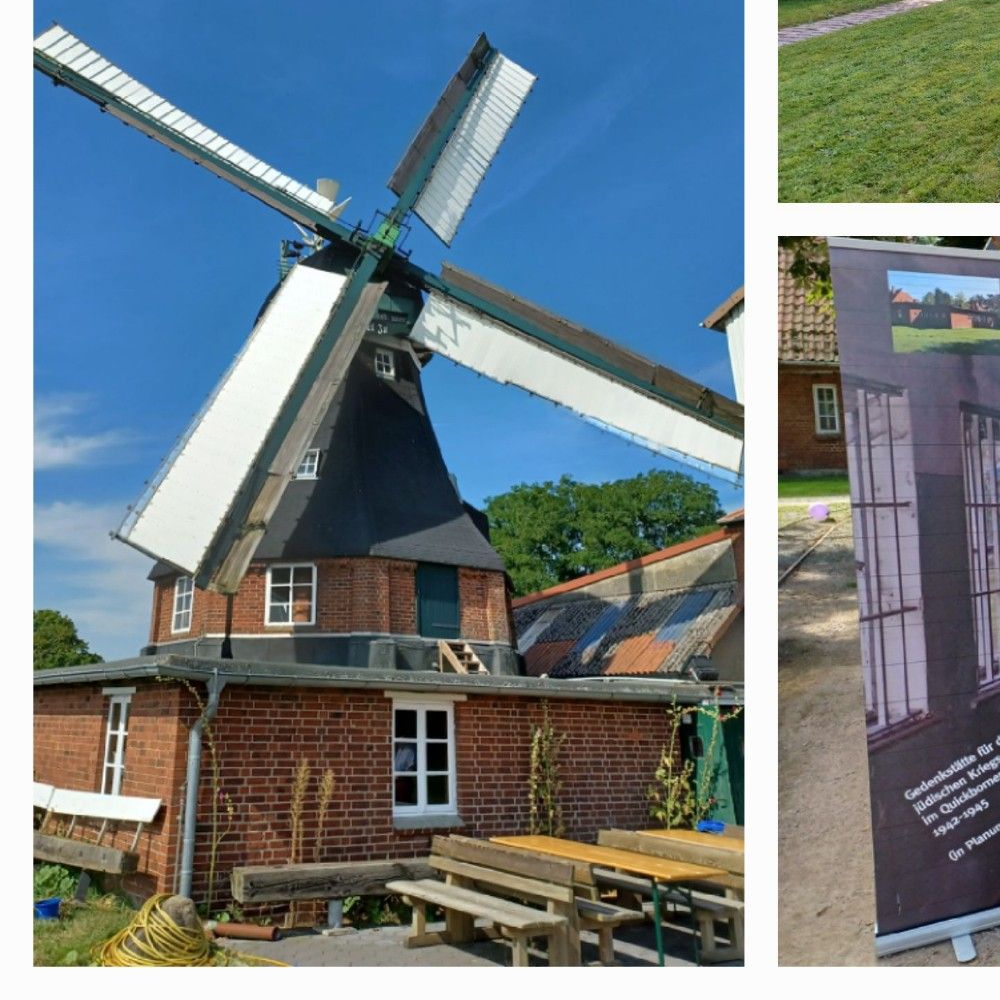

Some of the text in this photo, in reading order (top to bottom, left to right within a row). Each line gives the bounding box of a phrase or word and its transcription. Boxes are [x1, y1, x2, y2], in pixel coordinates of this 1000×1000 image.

[904, 754, 977, 800] Gedenkstätte
[976, 742, 994, 757] für
[912, 778, 967, 815] jüdischen
[921, 812, 939, 826] im
[932, 799, 989, 837] 1942-1945
[948, 848, 965, 862] (in
